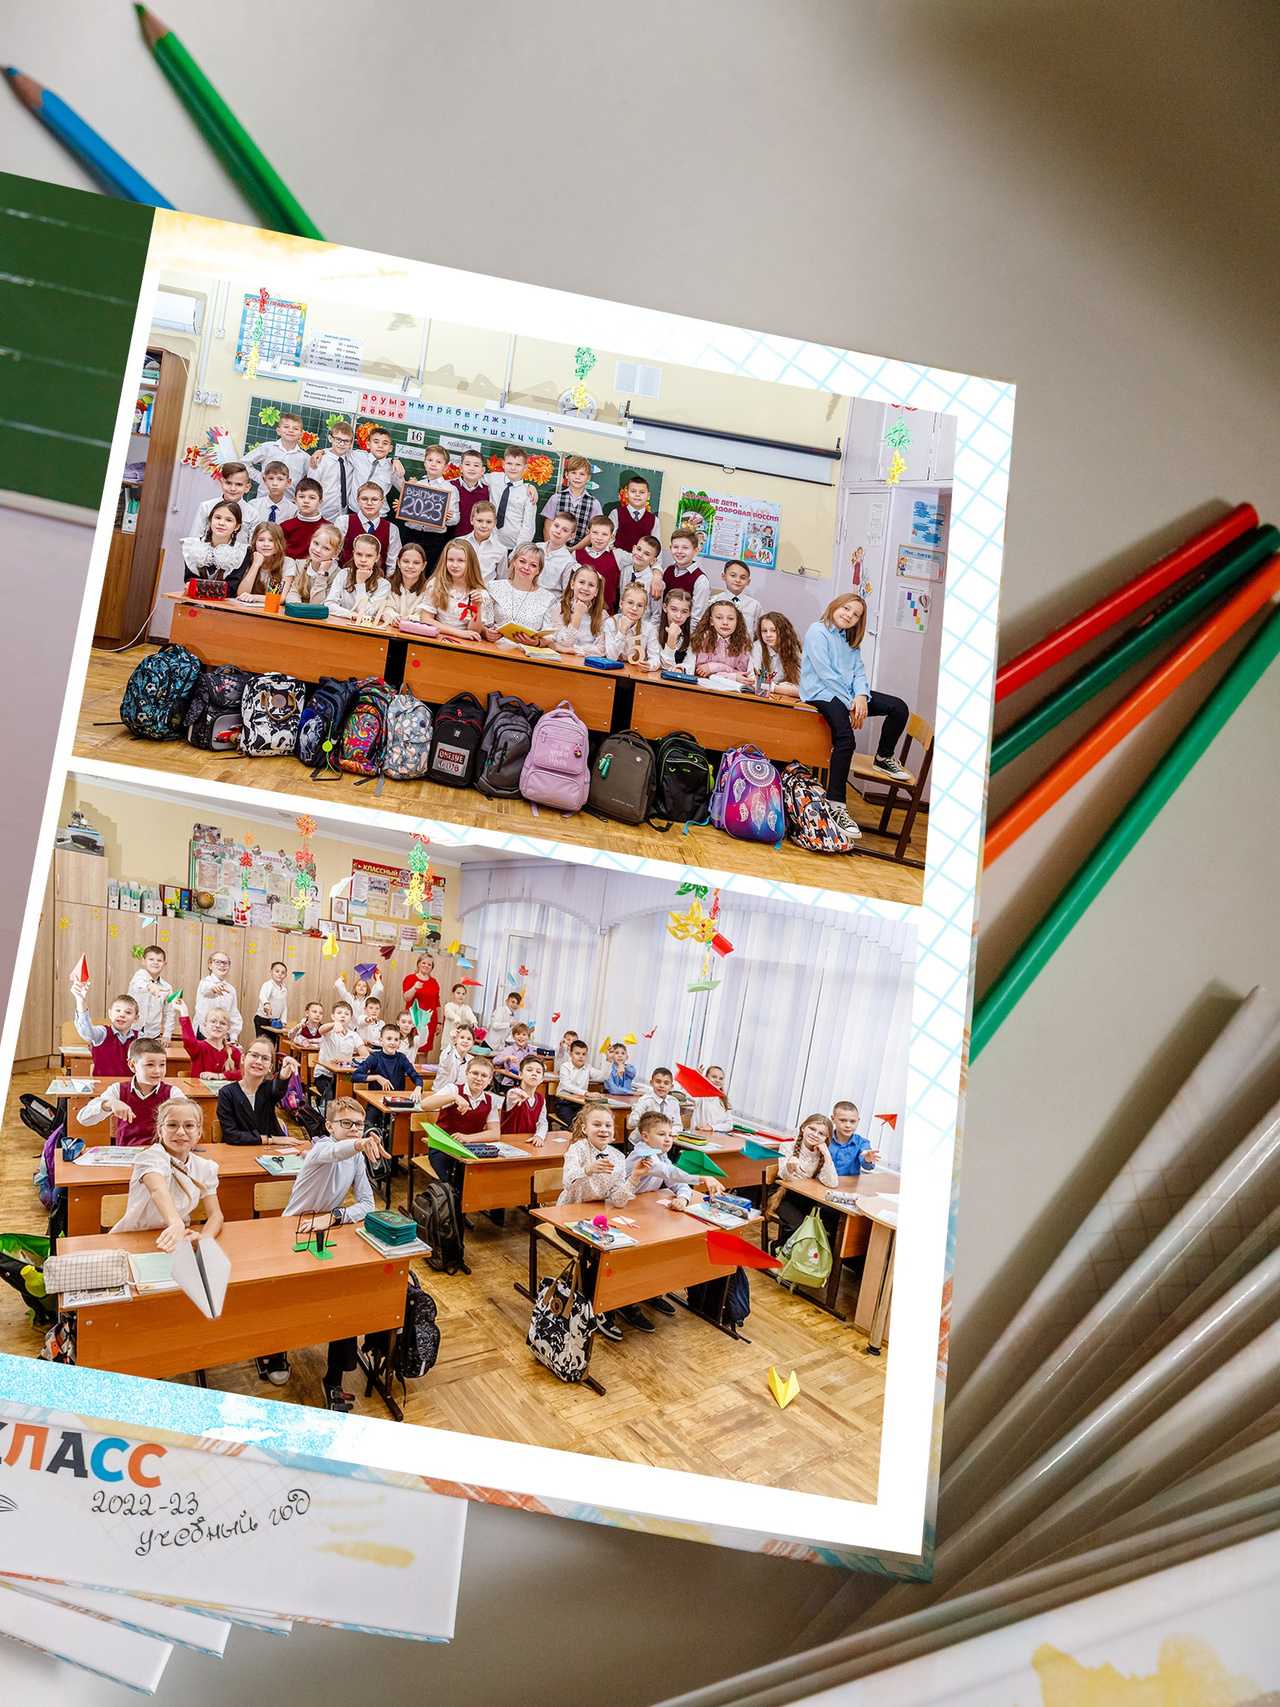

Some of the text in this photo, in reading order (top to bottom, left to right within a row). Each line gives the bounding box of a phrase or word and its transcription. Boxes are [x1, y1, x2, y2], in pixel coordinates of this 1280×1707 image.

[411, 431, 423, 442] 16
[406, 486, 446, 504] ВЫПУСК
[682, 492, 738, 508] ЗДОРОВЫЕ ДЕТИ
[400, 495, 443, 522] 2023
[714, 505, 779, 522] ЗДОРОВАЯ РОССИЯ
[627, 634, 646, 665] 5
[362, 864, 398, 877] КЛАССНЫЙ
[91, 1490, 199, 1516] 2022-23
[135, 1488, 311, 1557] учебный год
